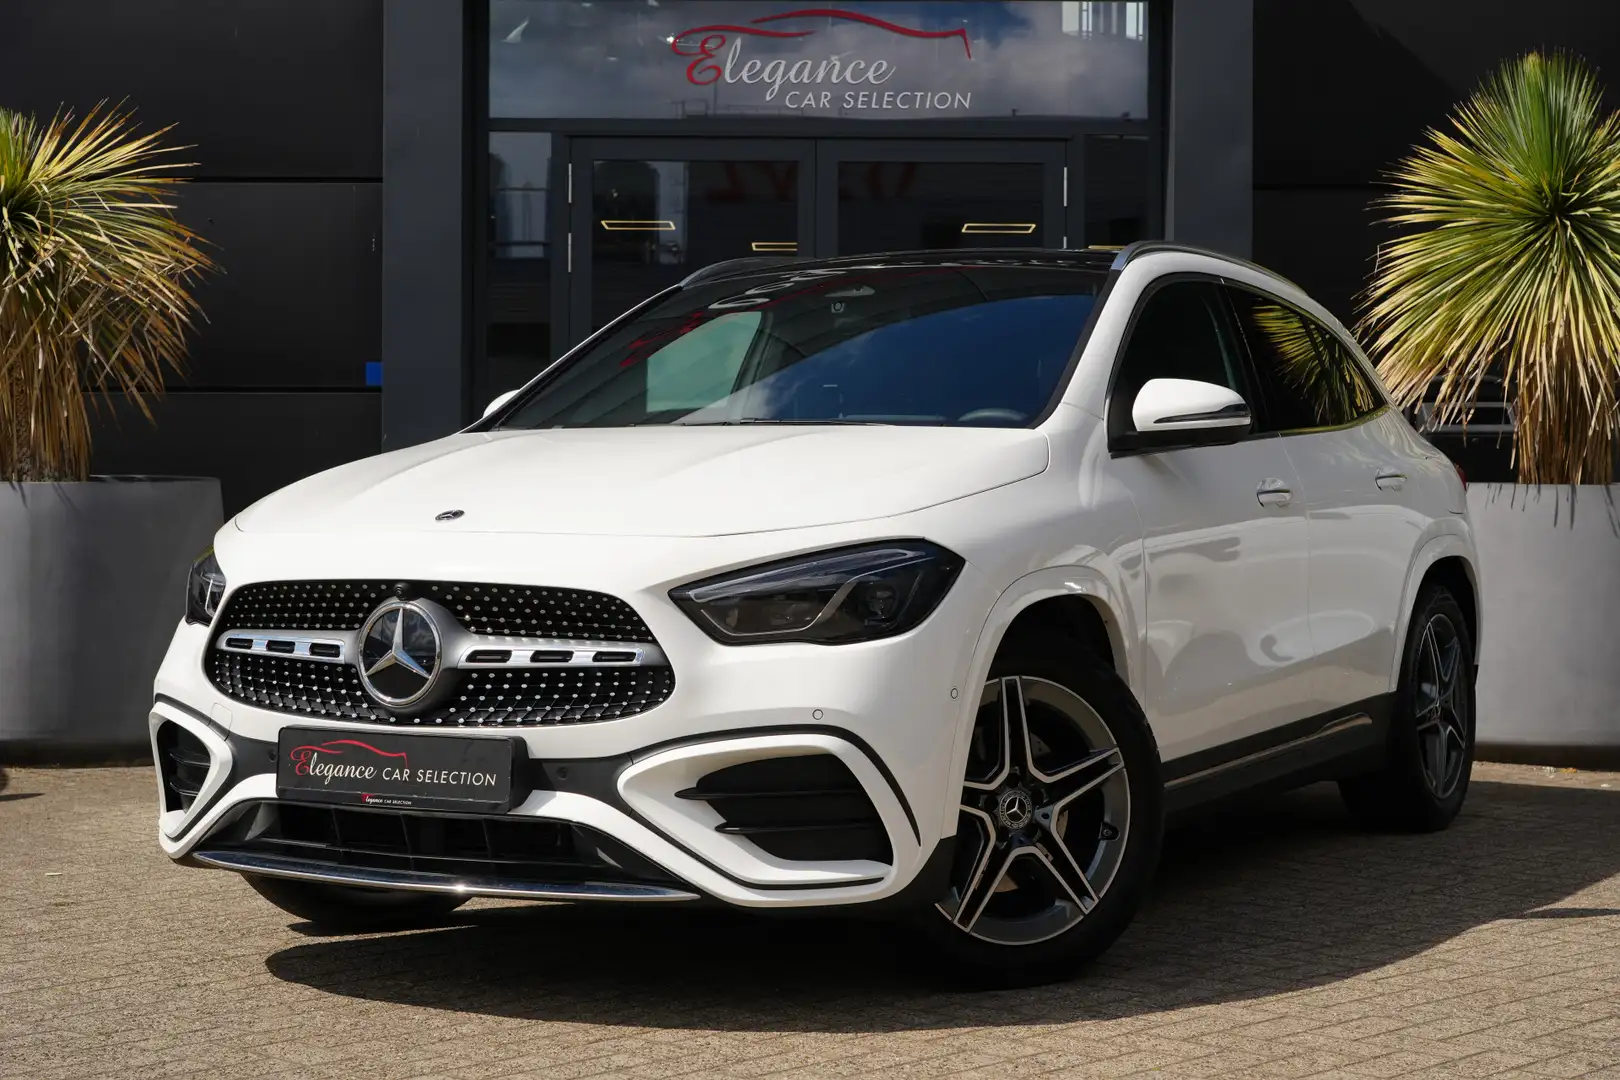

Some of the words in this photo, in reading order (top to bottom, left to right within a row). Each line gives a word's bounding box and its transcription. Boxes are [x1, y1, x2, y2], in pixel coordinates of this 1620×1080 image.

[672, 33, 896, 101] Elegance
[785, 91, 831, 109] CAR
[842, 91, 972, 110] SELECTION
[290, 750, 377, 785] Elegance
[382, 767, 410, 782] CAR
[416, 769, 497, 787] SELECTION
